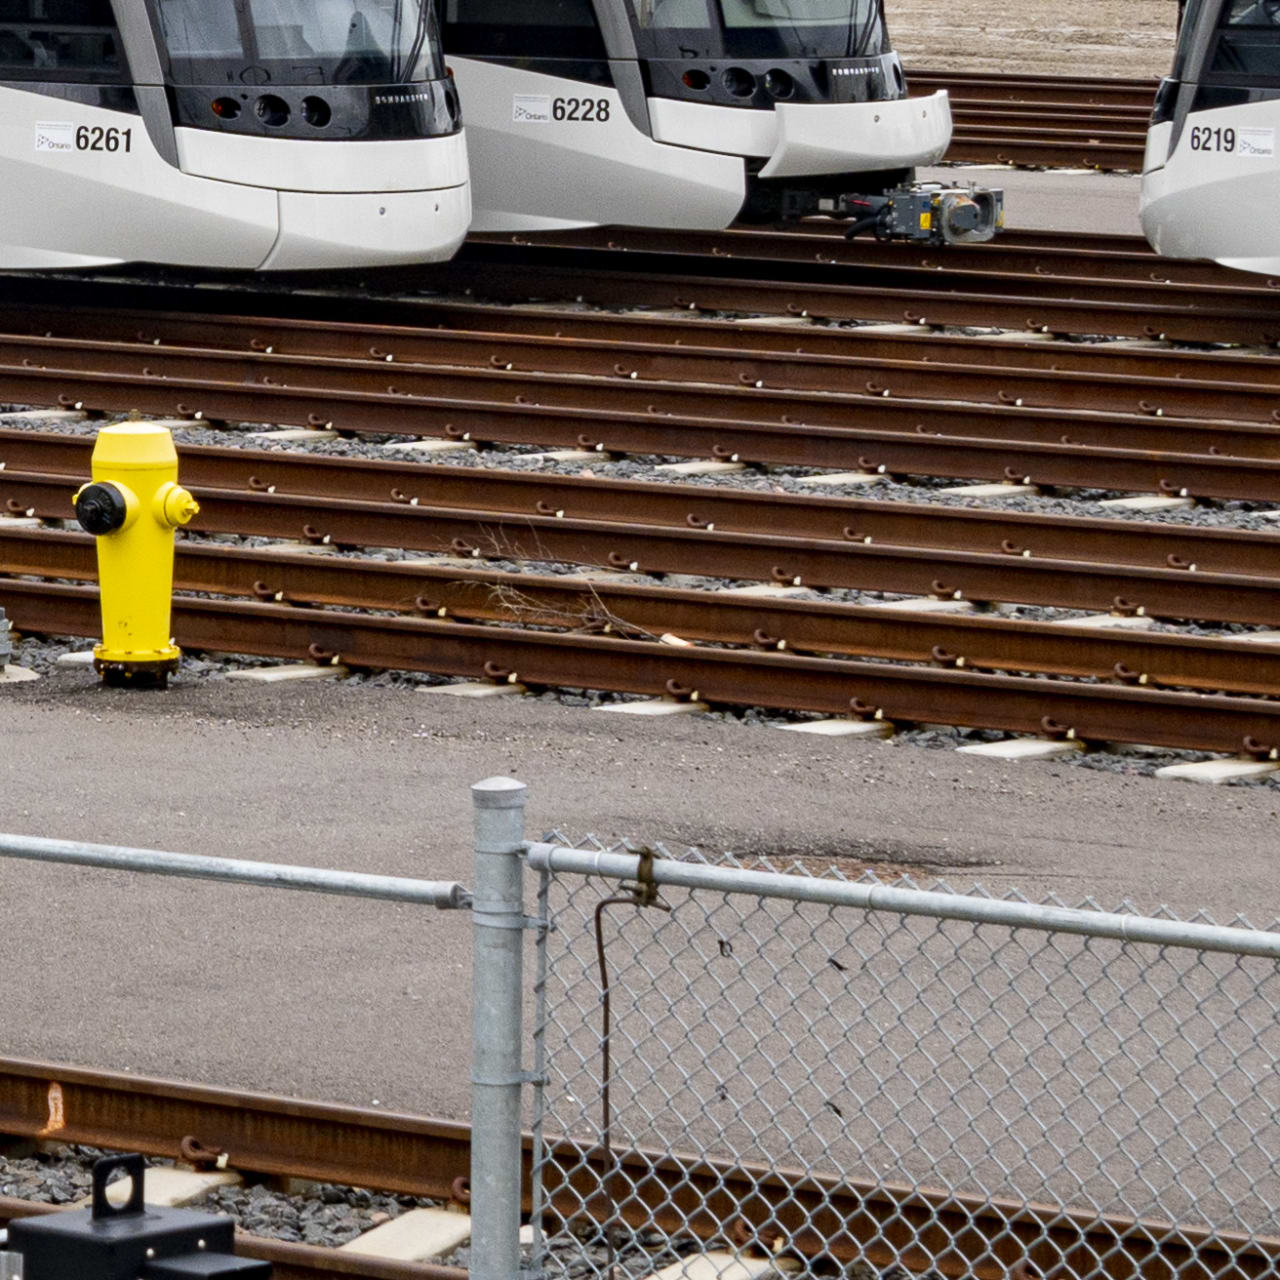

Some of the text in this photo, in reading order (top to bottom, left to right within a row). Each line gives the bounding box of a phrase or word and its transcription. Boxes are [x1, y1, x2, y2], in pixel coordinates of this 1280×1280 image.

[552, 97, 610, 122] 6228
[76, 125, 132, 153] 6261
[1191, 126, 1235, 152] 6219
